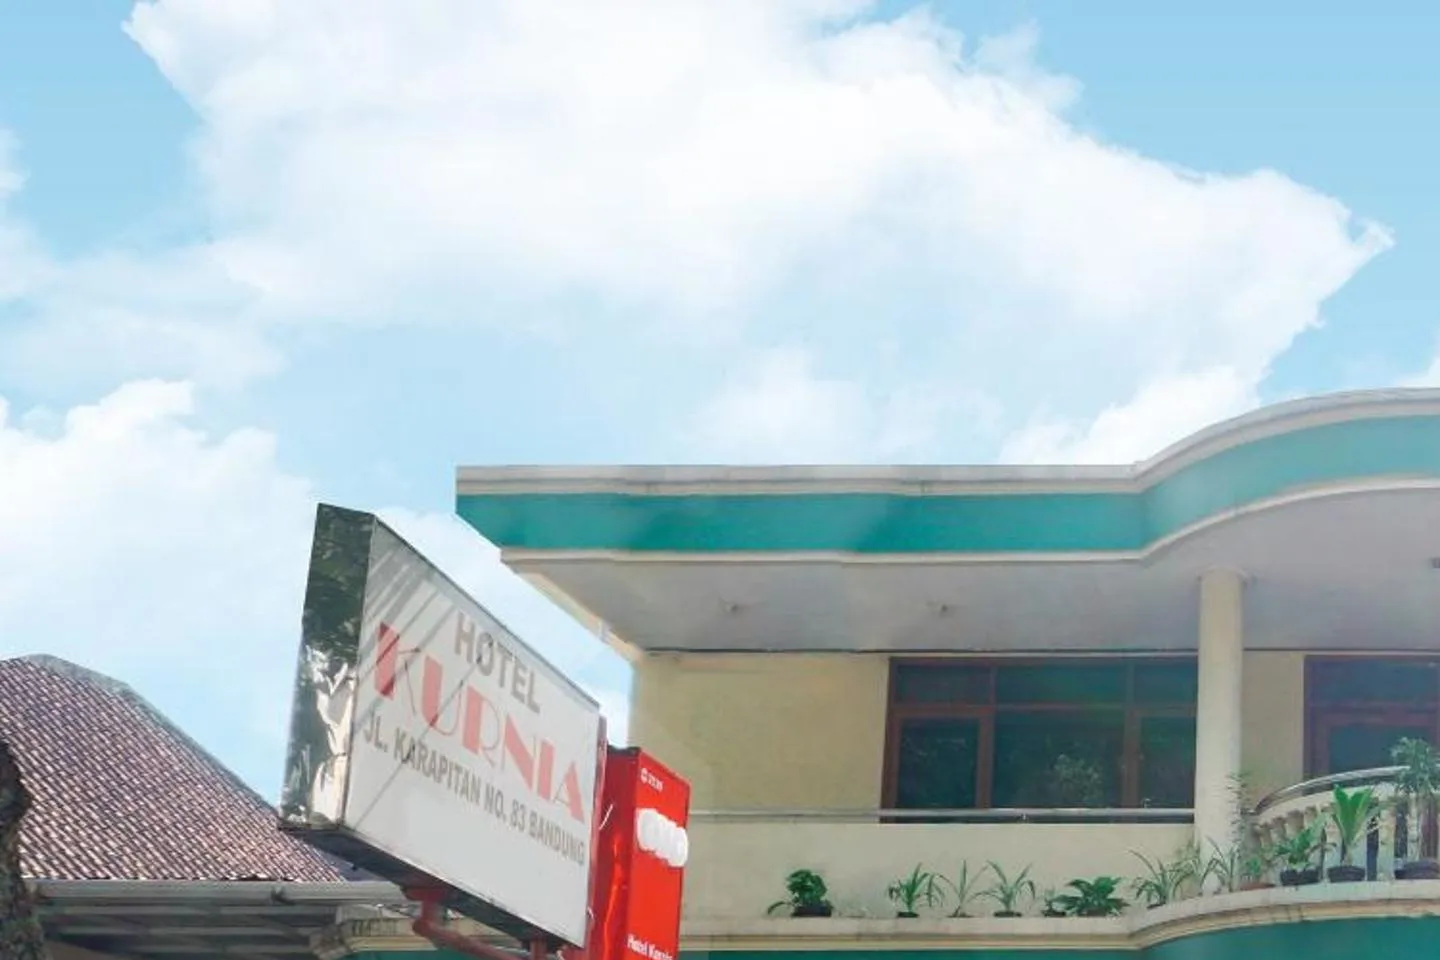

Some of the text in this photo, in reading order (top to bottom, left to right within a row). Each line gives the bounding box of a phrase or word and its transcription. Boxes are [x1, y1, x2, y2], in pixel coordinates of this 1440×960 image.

[373, 620, 586, 826] KURNIA
[454, 611, 541, 715] HOTEL
[393, 727, 481, 806] KARAPITAN
[484, 783, 507, 823] NO.
[510, 798, 526, 833] 83
[528, 809, 585, 867] BANDUNG
